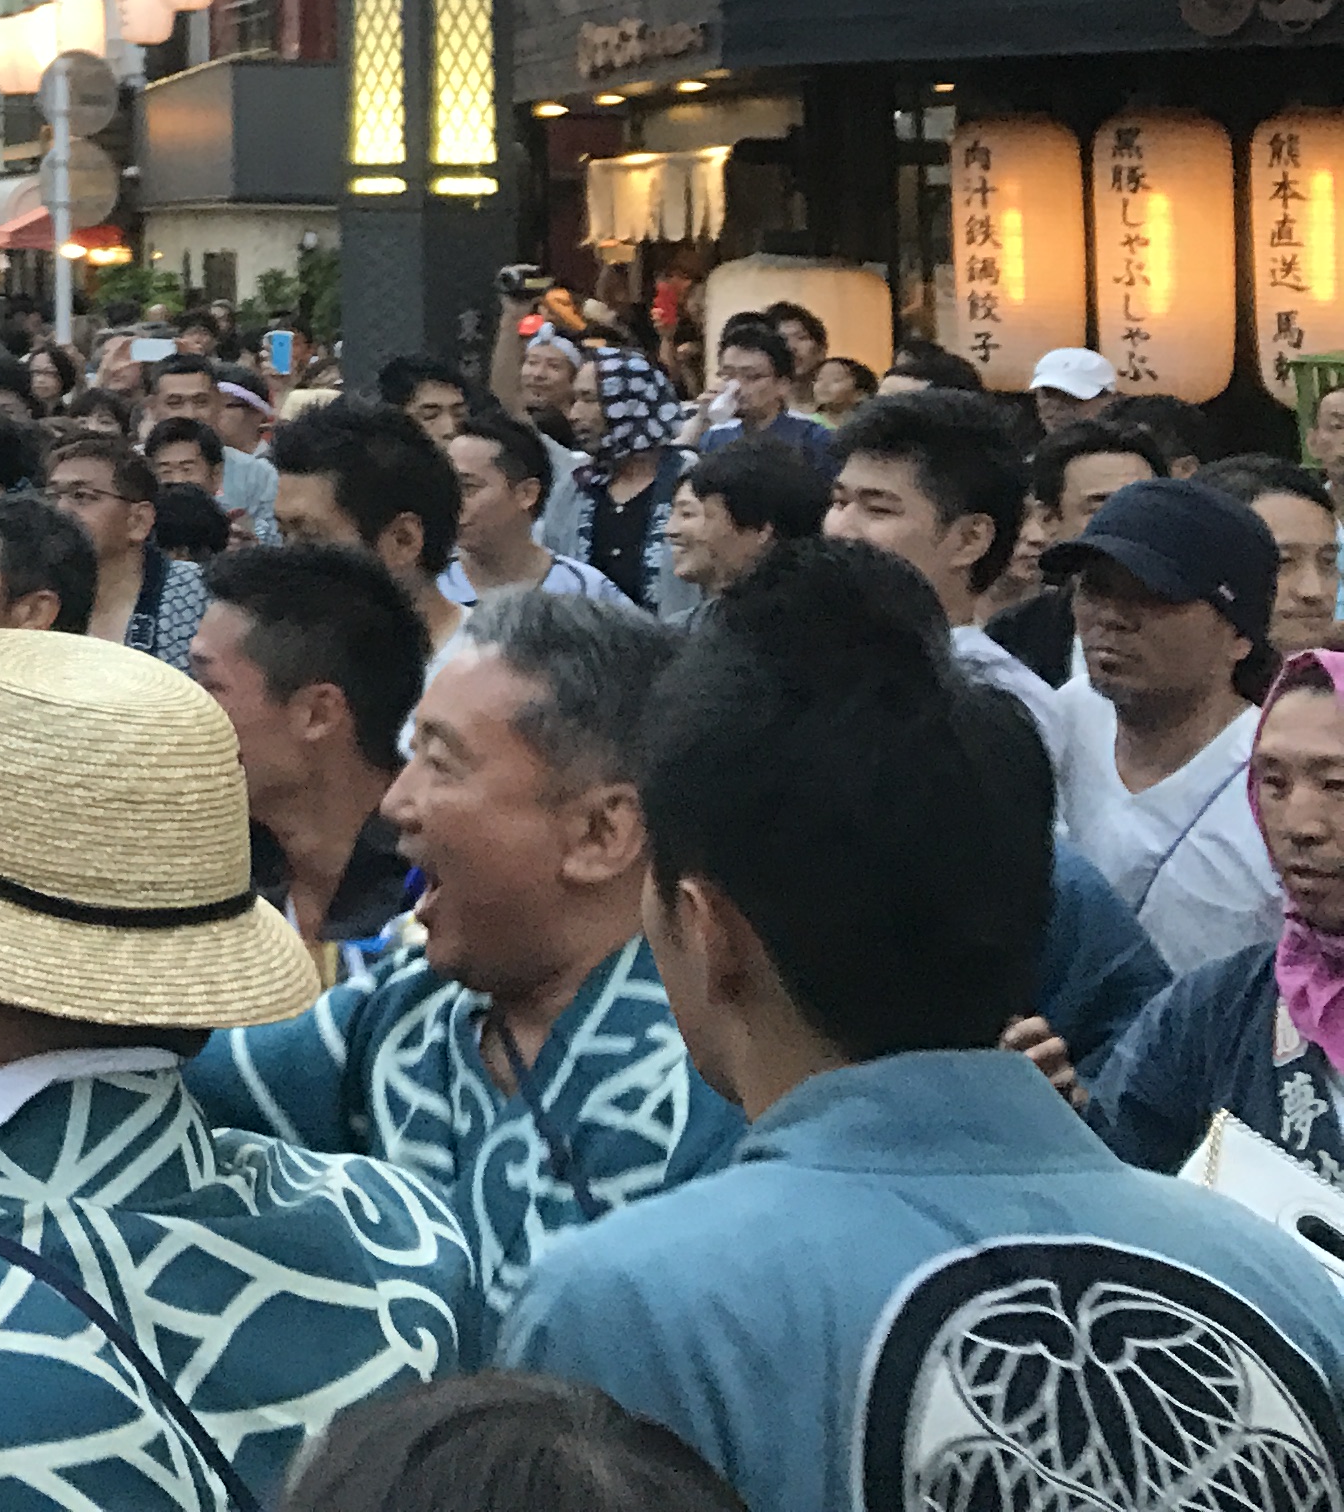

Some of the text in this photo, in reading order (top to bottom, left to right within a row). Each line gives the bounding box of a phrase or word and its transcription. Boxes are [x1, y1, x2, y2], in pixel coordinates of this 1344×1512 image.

[964, 139, 1004, 364] 肉汁鉄鍋餃子
[1113, 127, 1159, 382] 黒豚しゃぶしゃぶ
[1267, 132, 1312, 292] 熊本直送
